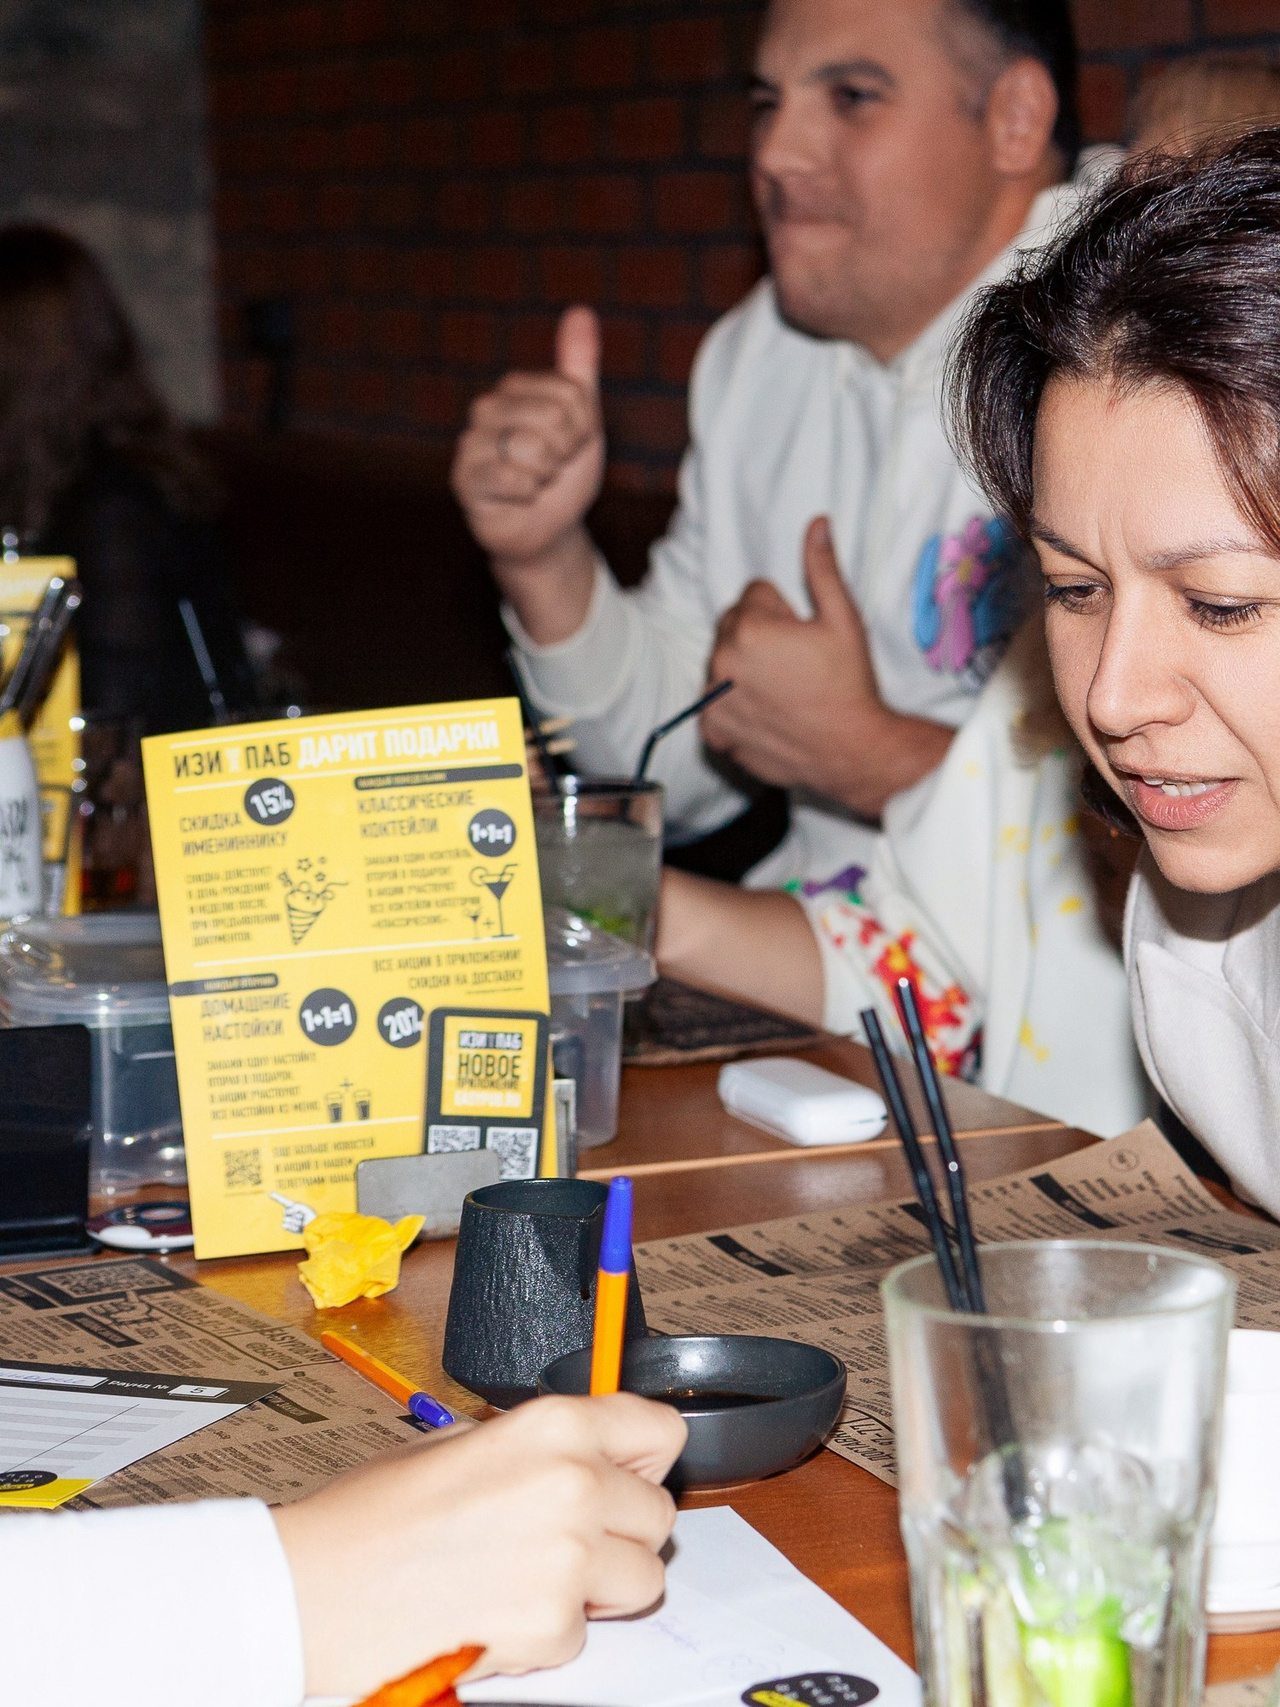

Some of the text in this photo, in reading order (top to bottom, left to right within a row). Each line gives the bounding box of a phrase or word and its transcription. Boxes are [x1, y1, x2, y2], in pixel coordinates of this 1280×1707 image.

[174, 720, 500, 778] ИЗИ ПАБ ДАРИТ ПОДАРКИ
[250, 785, 294, 819] 15%
[359, 789, 474, 814] КЛАССИЧЕСКИЕ
[180, 811, 243, 833] СКИДКА
[360, 816, 439, 838] КОКТЕЙЛИ
[183, 831, 288, 856] ИМЕНИННИКУ
[202, 993, 290, 1018] ДОМАШНИЕ
[301, 1003, 353, 1033] 1+1=1
[203, 1017, 285, 1043] НАСТОЙКИ
[383, 1005, 424, 1042] 20%
[458, 1053, 522, 1078] НОВОЕ
[108, 1379, 150, 1391] раунд
